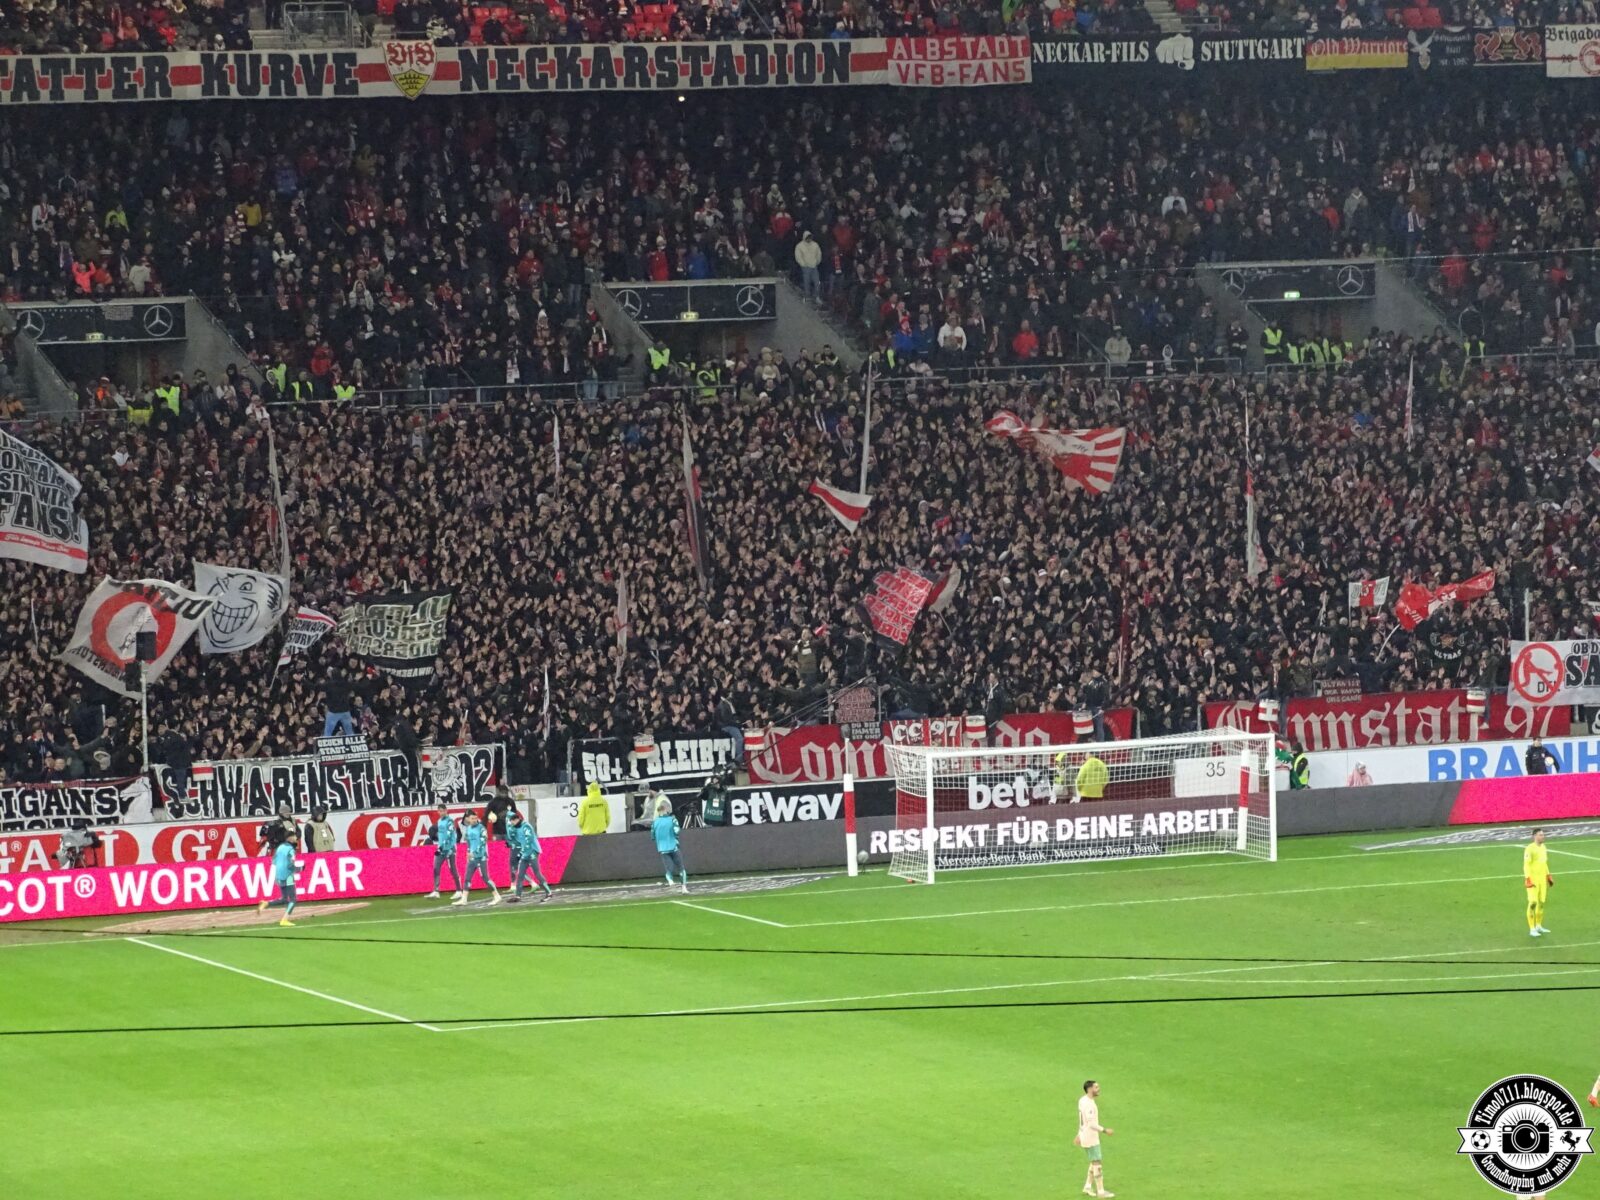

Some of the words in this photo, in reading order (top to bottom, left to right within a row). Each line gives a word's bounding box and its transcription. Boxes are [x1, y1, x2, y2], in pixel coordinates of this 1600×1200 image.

[892, 35, 1028, 60] ALBSTADT
[1033, 41, 1149, 63] NECKAR-FILS
[1200, 37, 1305, 61] STUTTGART
[0, 55, 172, 100] ATTER
[201, 52, 359, 98] KURVE
[459, 42, 851, 92] NECKARSTADION
[895, 59, 1027, 85] VFB-FANS
[1565, 654, 1600, 686] SA
[345, 736, 367, 745] ALLE
[1205, 762, 1226, 778] 35
[0, 786, 119, 820] IGANS
[730, 788, 844, 827] etway
[968, 776, 1030, 811] bet
[870, 822, 990, 855] RESPEKT
[997, 815, 1050, 847] FÜR
[1056, 813, 1139, 842] DEINE
[1141, 807, 1234, 836] ARBEIT
